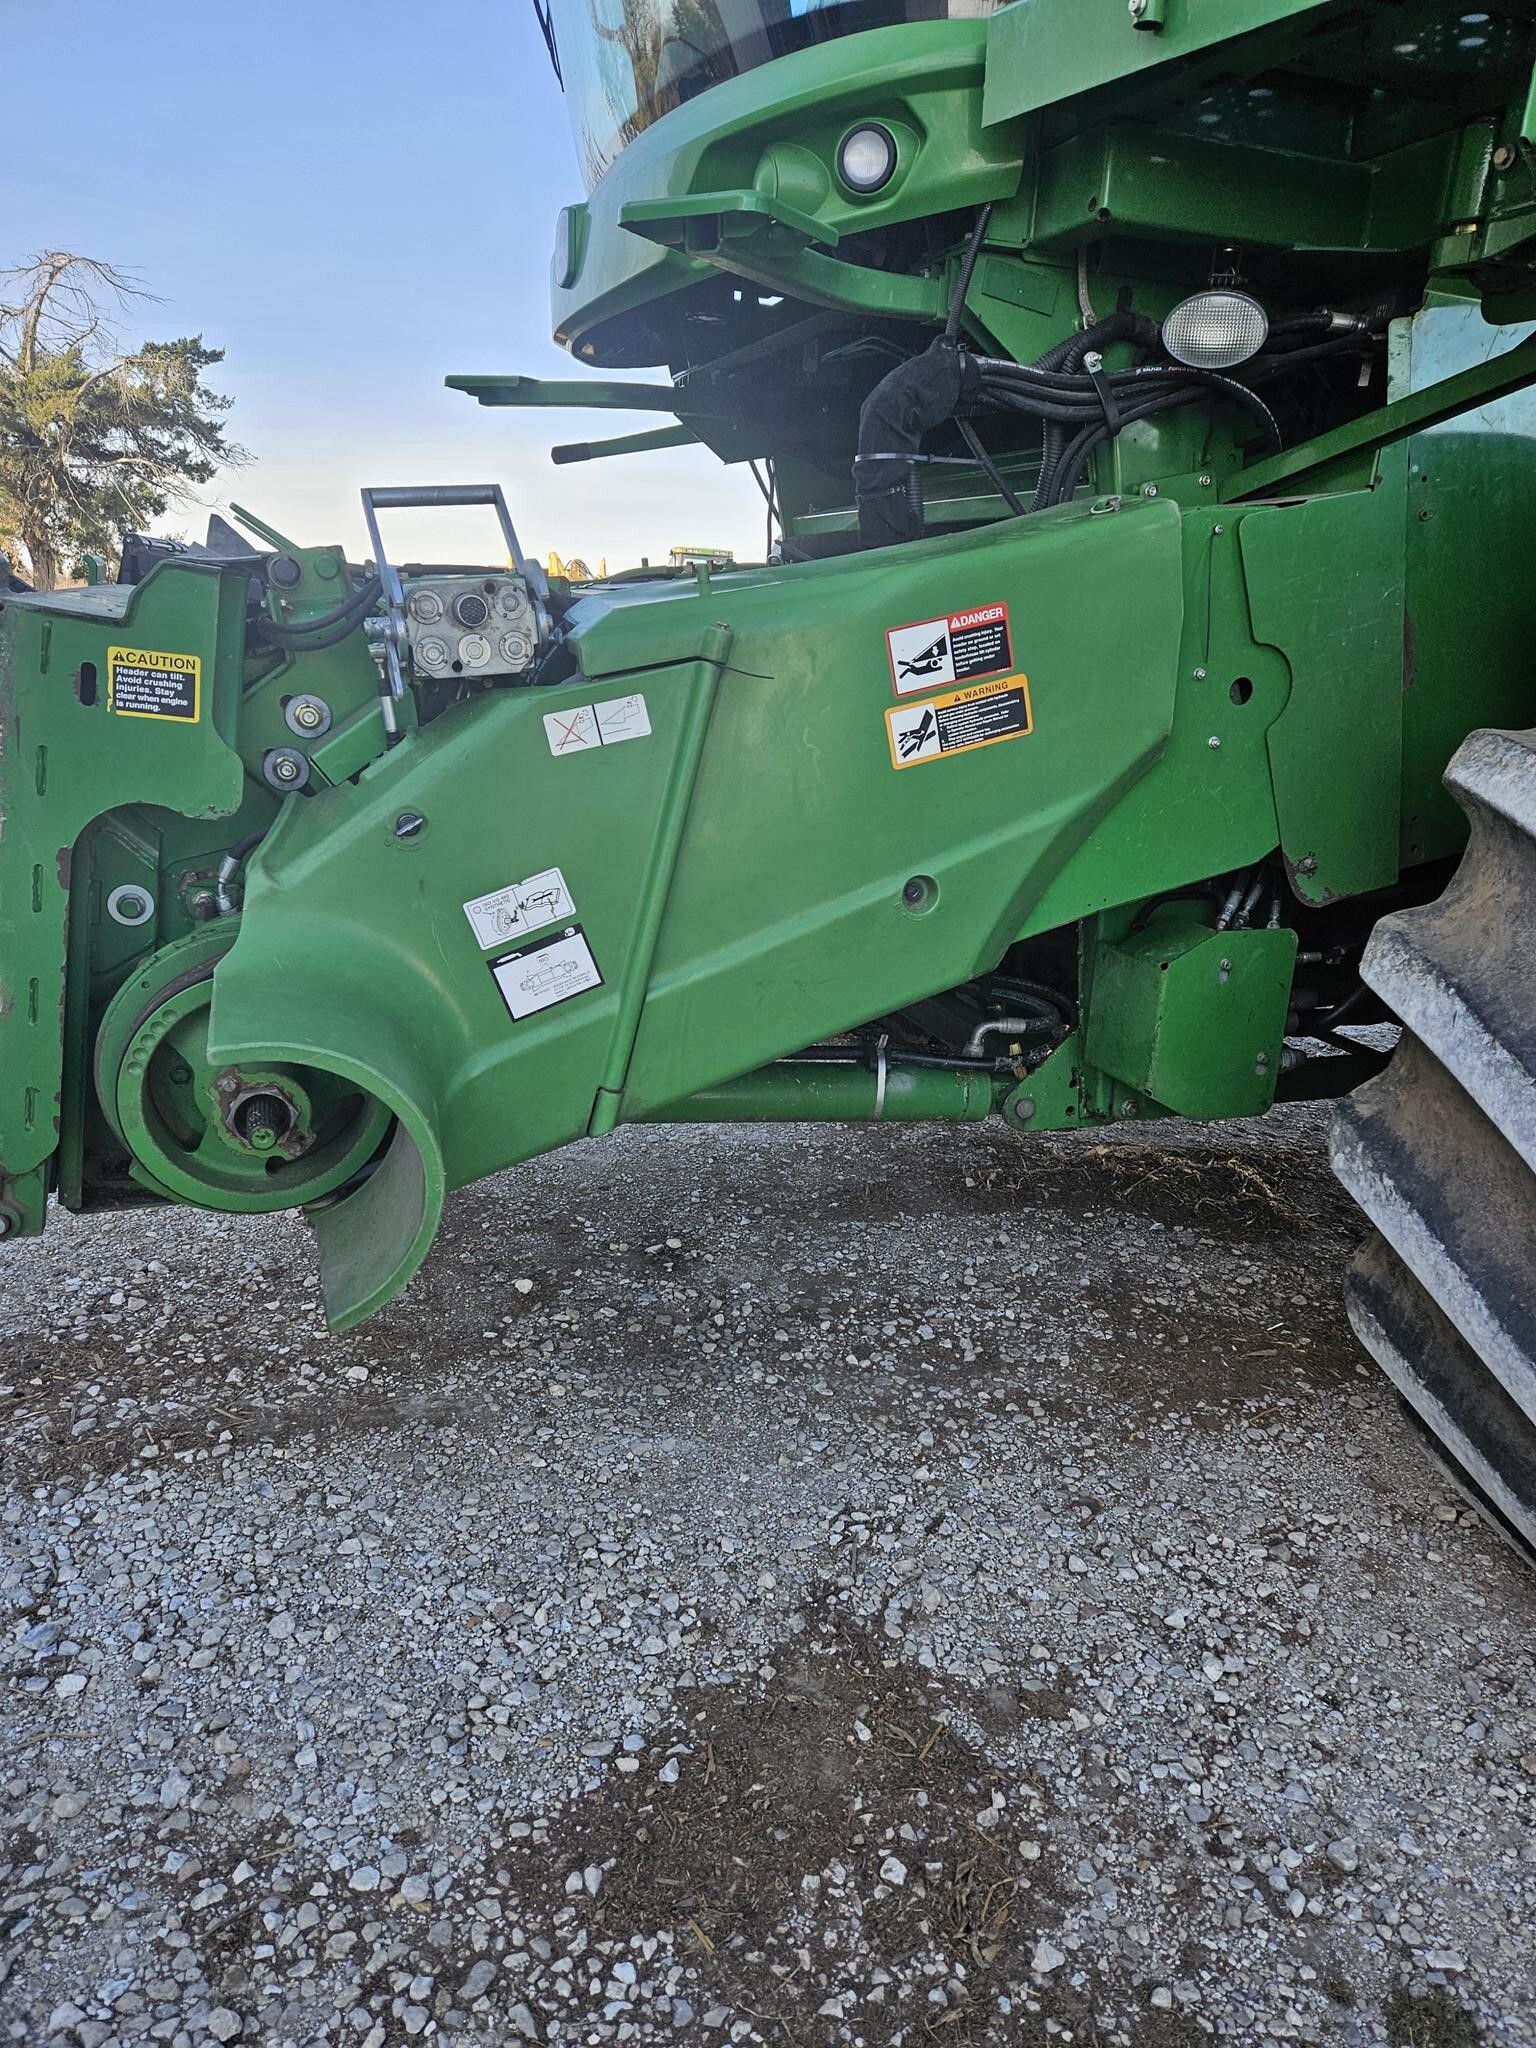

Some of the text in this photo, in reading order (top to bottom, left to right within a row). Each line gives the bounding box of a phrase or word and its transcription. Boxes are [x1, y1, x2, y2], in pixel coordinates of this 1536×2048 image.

[960, 607, 1003, 626] DANGER
[126, 652, 196, 670] CAUTION
[116, 666, 185, 681] Header can tilt.
[116, 675, 183, 690] Avoid crushing
[964, 681, 1009, 699] WARNING
[116, 691, 188, 707] clear when engine
[155, 687, 175, 698] Stay
[125, 701, 161, 712] running.
